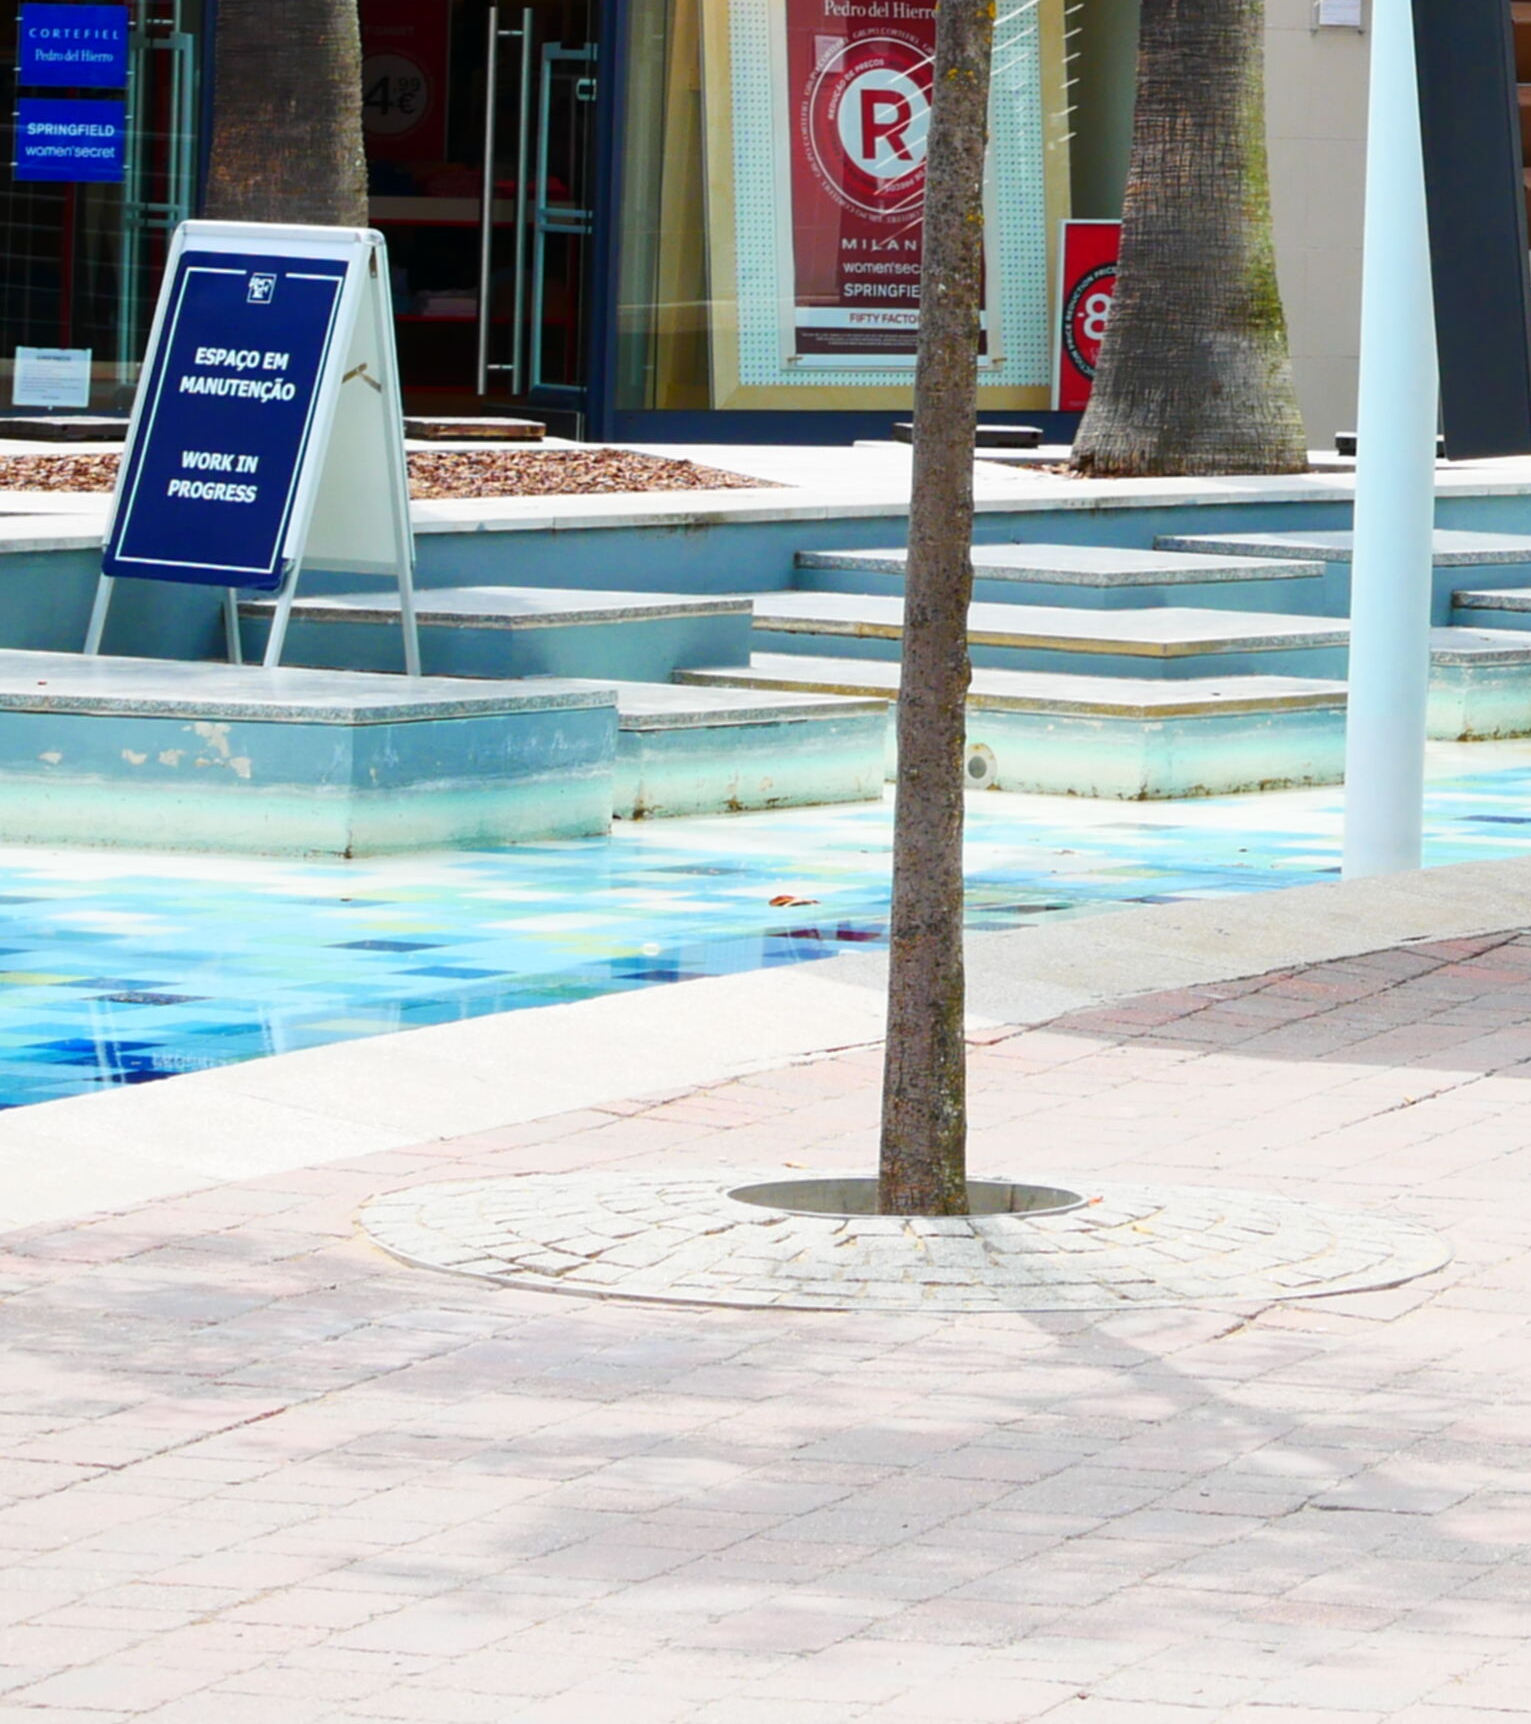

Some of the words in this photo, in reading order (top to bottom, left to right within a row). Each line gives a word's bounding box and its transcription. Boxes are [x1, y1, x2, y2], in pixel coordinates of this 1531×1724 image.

[868, 1, 889, 18] del
[28, 27, 119, 40] CORTEFIEL
[35, 48, 63, 62] Pedro
[64, 50, 79, 62] del
[81, 50, 114, 63] Hierro
[27, 122, 115, 137] SPRINGFIELD
[859, 87, 913, 161] R
[25, 145, 116, 158] women'secret
[843, 282, 920, 297] SPRINGFIE
[849, 313, 880, 323] FIFTY
[194, 347, 260, 371] ESPAÇO
[262, 352, 289, 370] EM
[179, 376, 296, 403] MANUTENÇÃO
[181, 450, 235, 472] WORK
[235, 455, 260, 474] IN
[166, 479, 258, 503] PROGRESS
